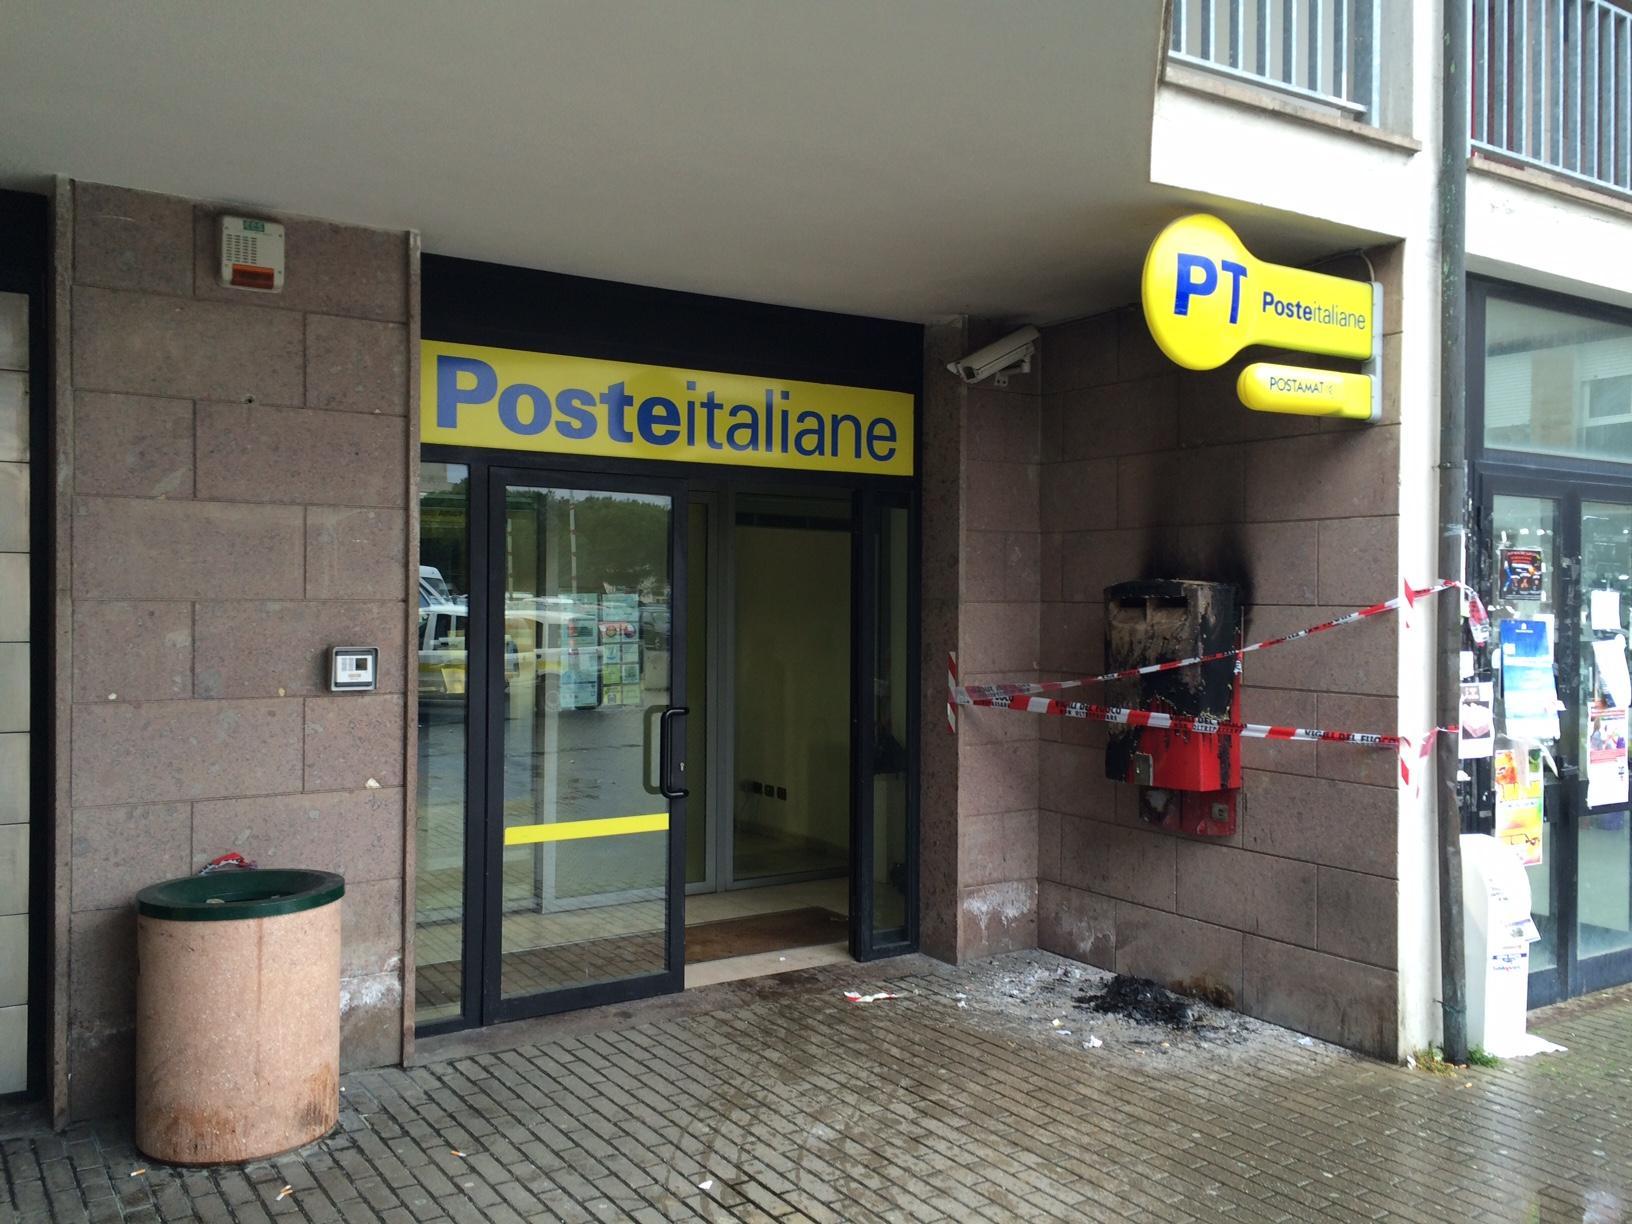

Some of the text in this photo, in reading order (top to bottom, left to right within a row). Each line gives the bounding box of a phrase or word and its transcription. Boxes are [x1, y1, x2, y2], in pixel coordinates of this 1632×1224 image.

[1174, 253, 1248, 324] PT
[1262, 291, 1366, 330] Posteitaliane
[435, 354, 897, 462] Posteitaliane
[1270, 376, 1325, 394] POSTAMAT
